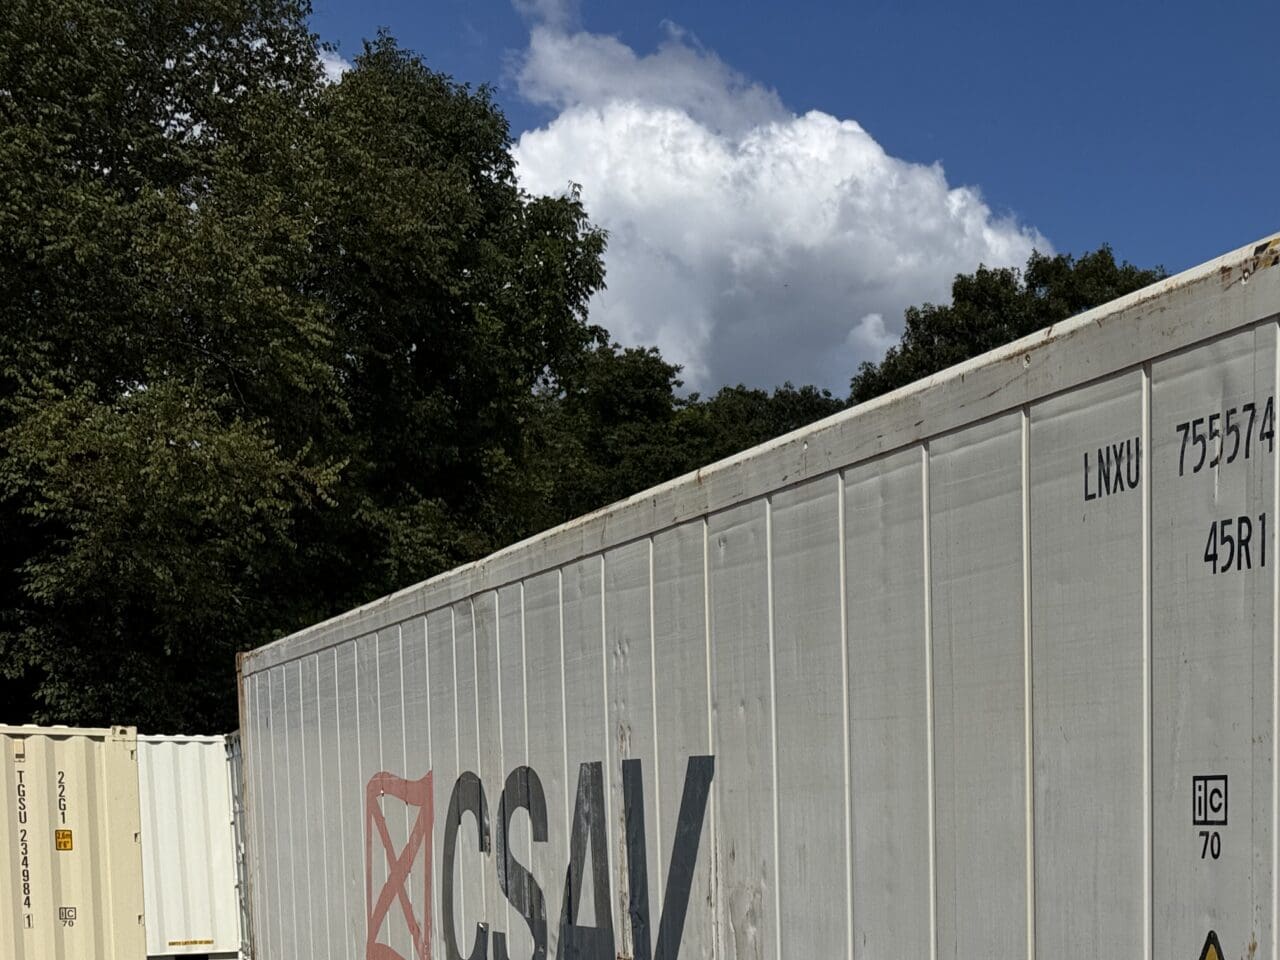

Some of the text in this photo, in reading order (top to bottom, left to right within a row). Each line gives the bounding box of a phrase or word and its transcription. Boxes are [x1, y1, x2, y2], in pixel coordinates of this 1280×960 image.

[1083, 436, 1140, 501] LNXU
[1175, 396, 1275, 477] 755574
[1203, 512, 1266, 575] 45R1
[16, 770, 27, 824] TGSU
[57, 770, 67, 825] 22G1
[20, 828, 31, 909] 234984
[1199, 831, 1222, 860] 70
